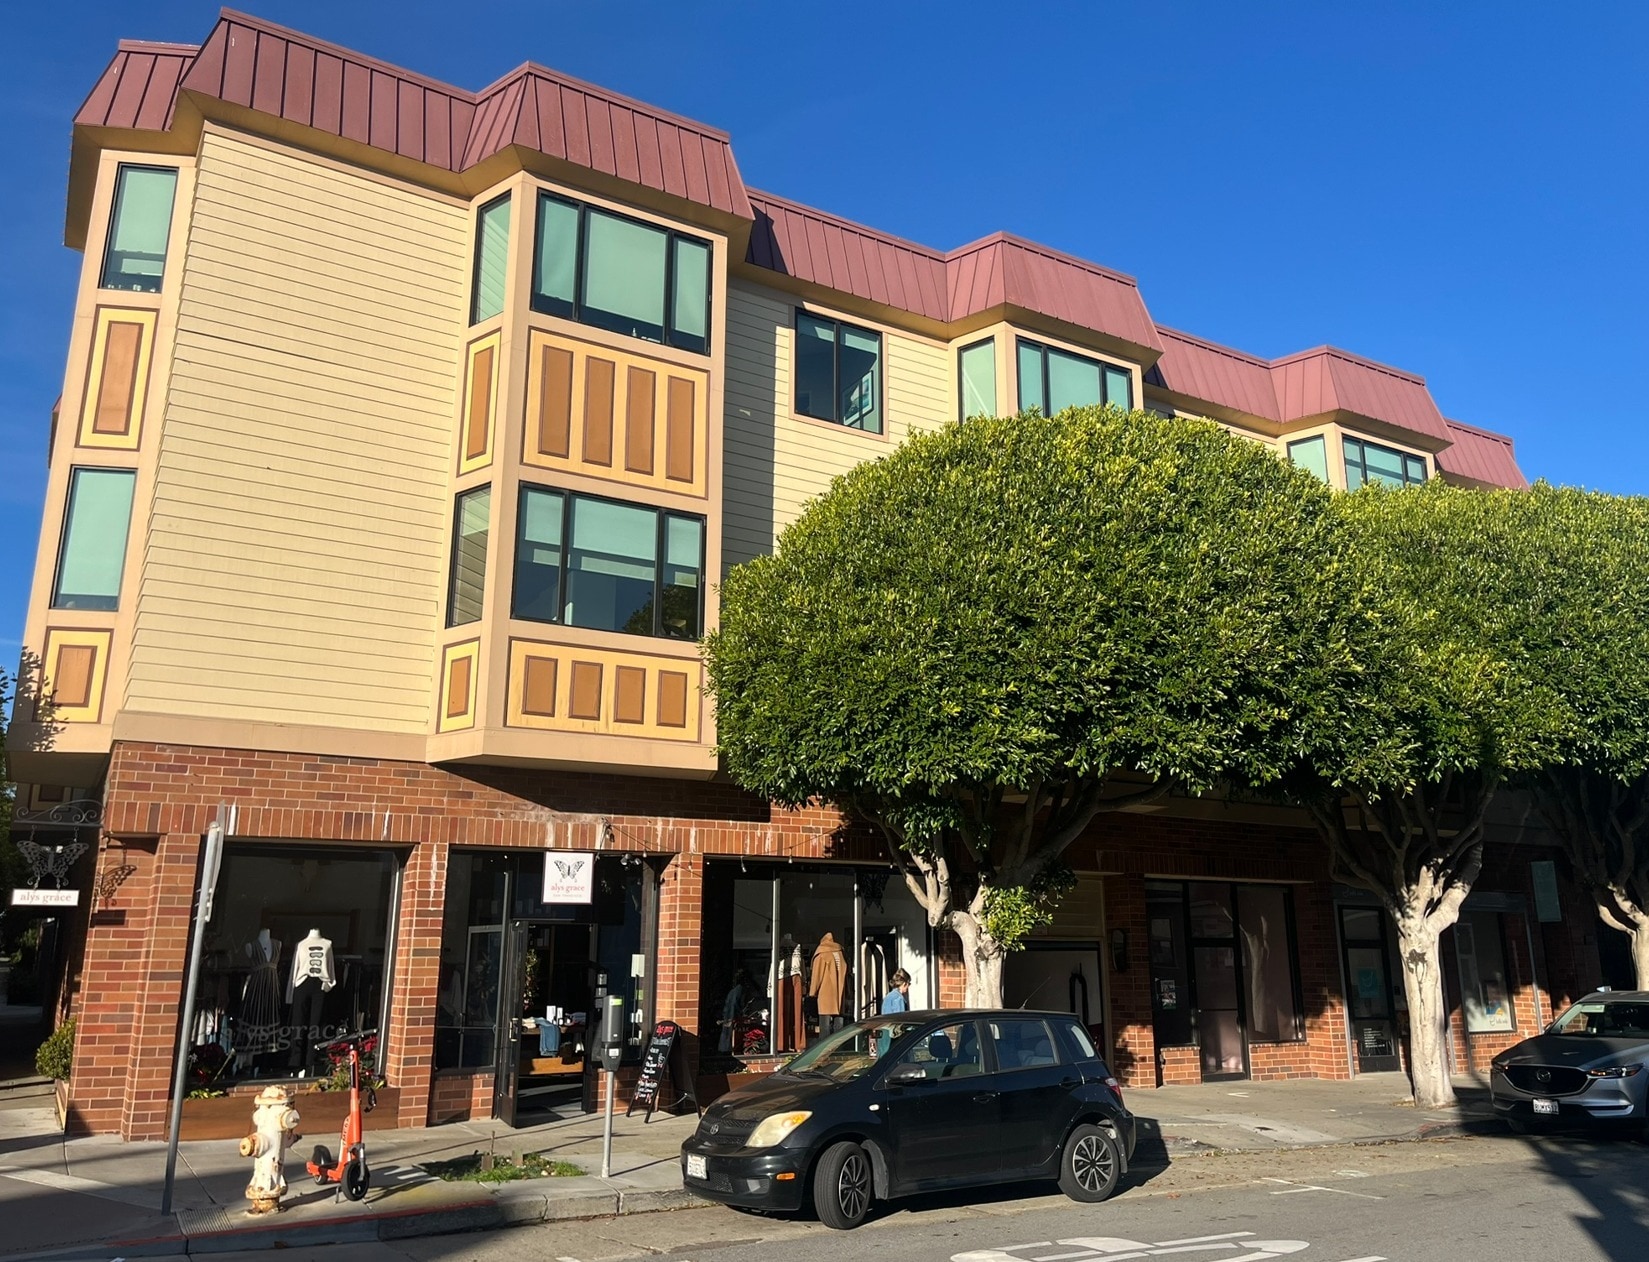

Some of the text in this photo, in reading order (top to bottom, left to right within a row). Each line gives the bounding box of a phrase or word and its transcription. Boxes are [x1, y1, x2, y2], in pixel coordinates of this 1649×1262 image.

[551, 883, 564, 893] alys
[20, 892, 72, 904] alys grace
